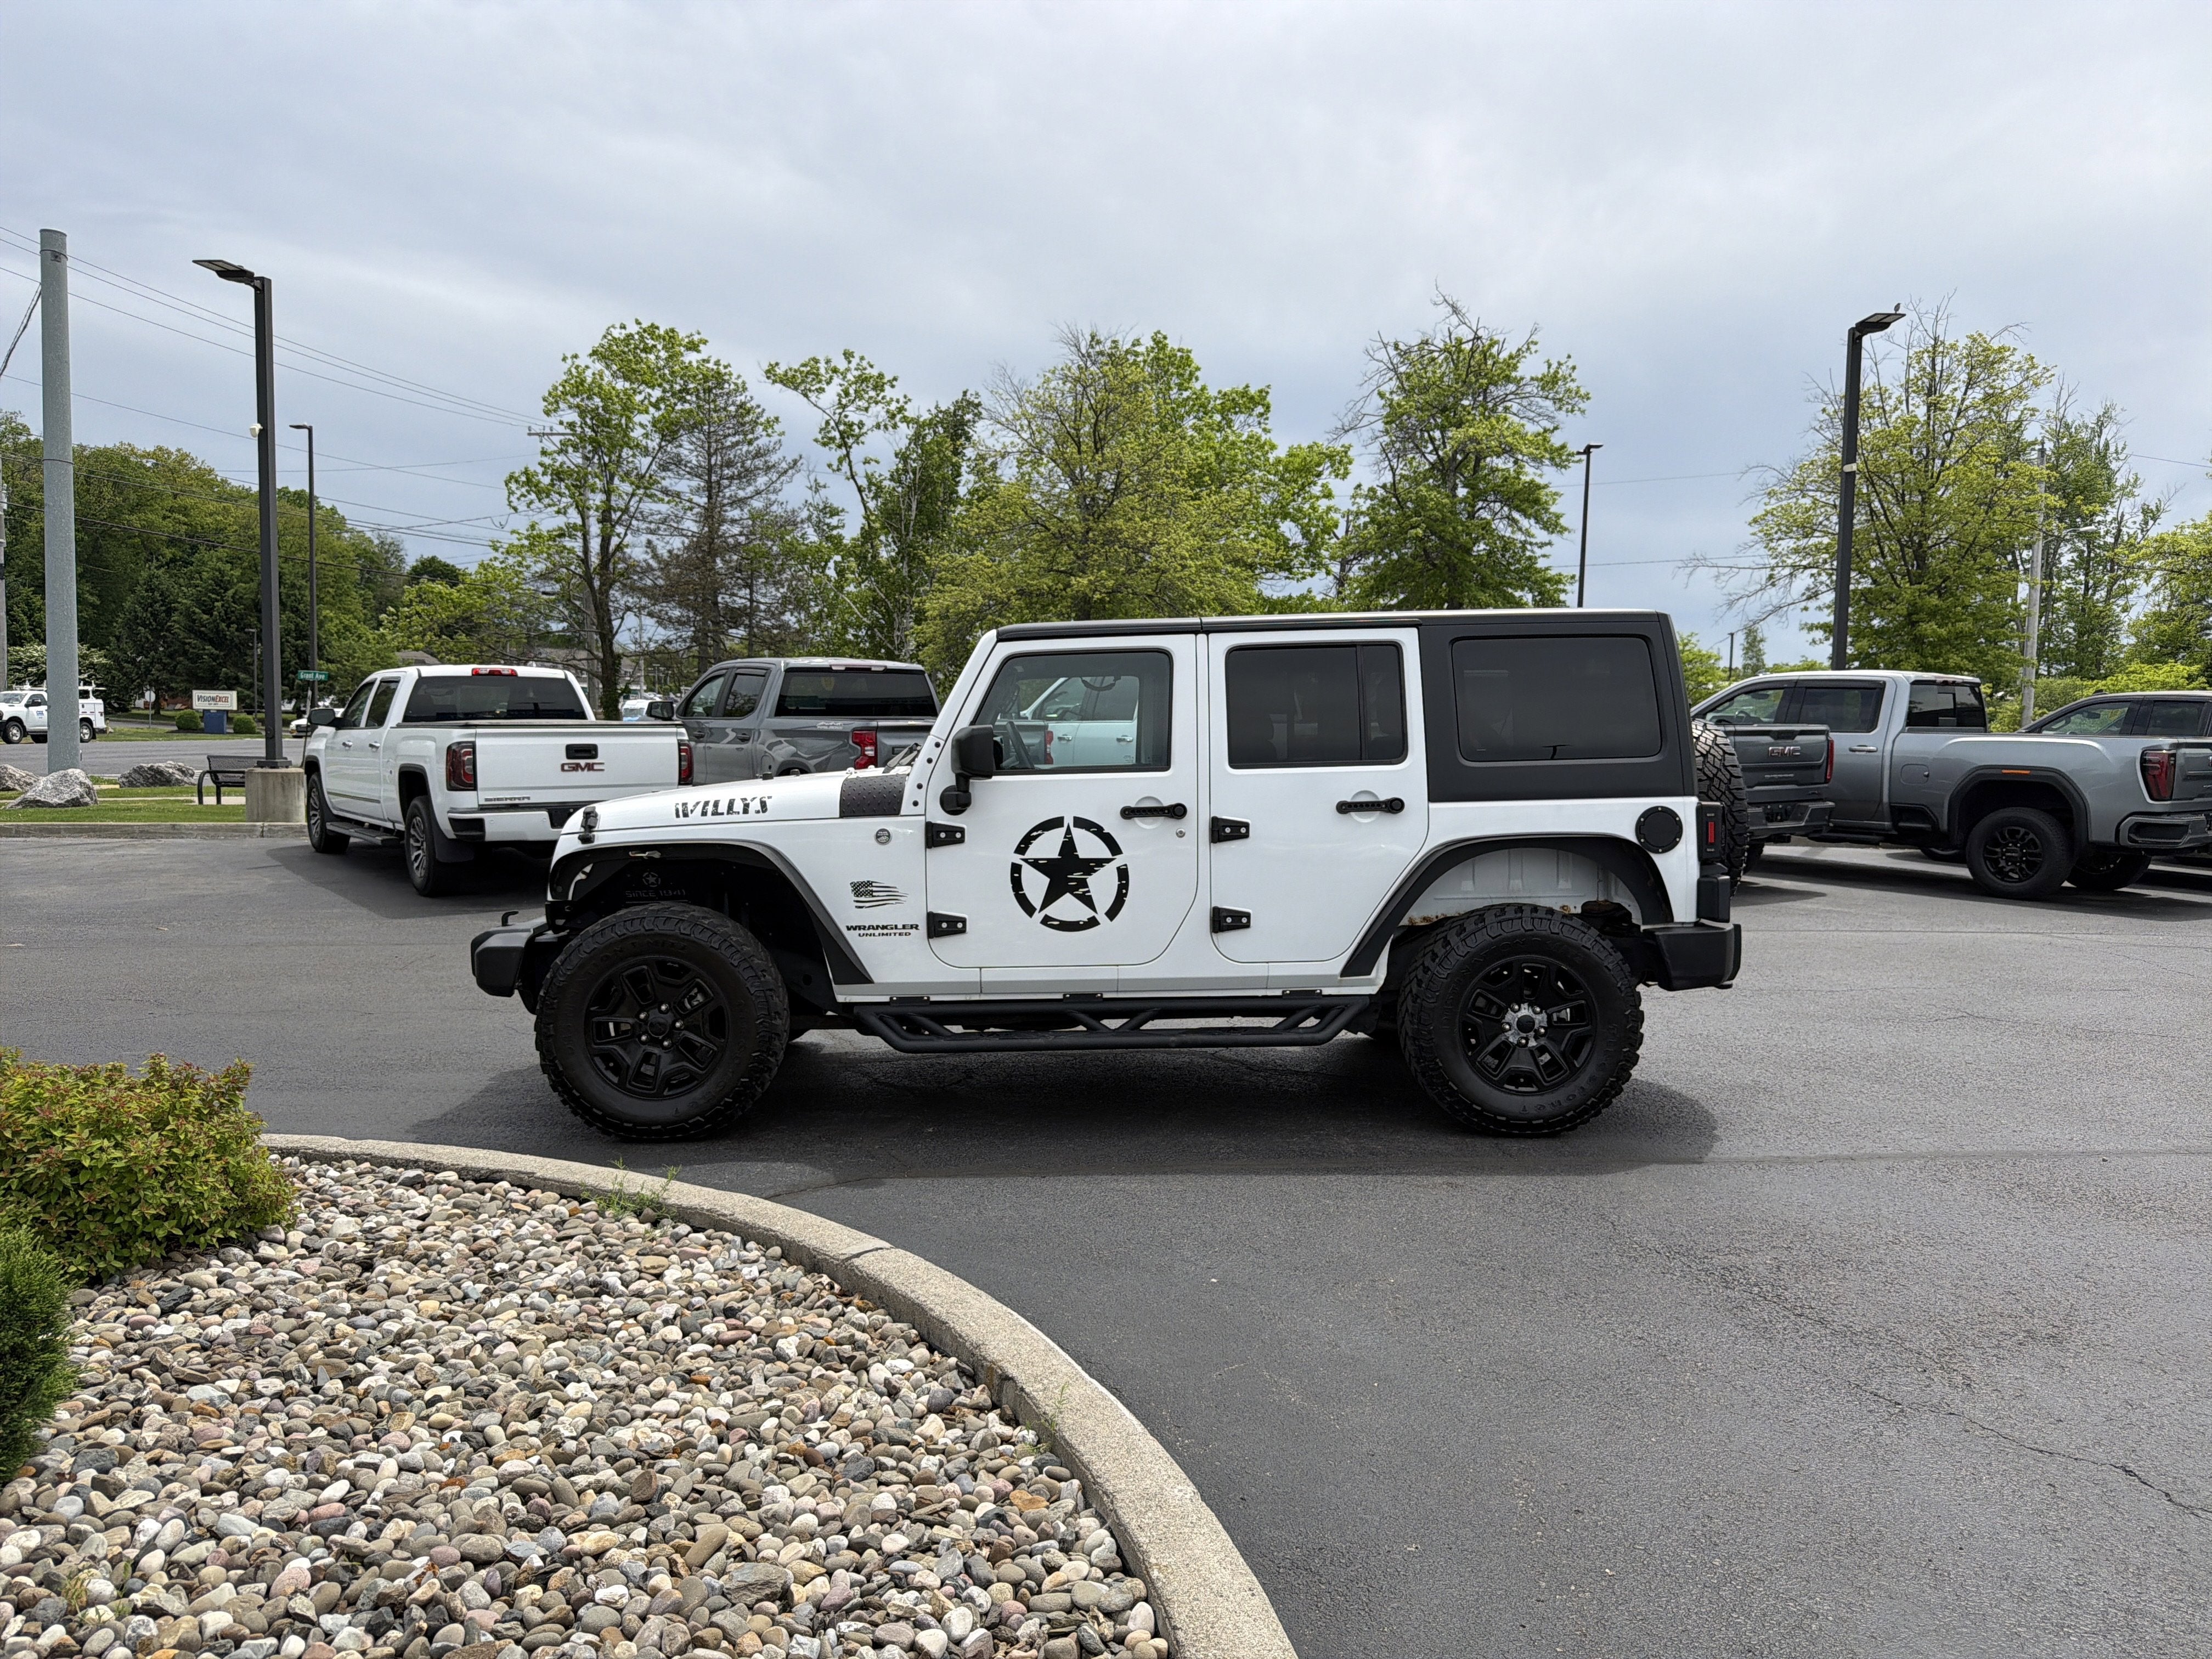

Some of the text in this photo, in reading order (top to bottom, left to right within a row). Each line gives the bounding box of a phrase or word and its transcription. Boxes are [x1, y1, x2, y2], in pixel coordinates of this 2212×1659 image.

[1768, 746, 1801, 757] GMC
[561, 763, 605, 772] GMC
[675, 796, 772, 819] WILLYS
